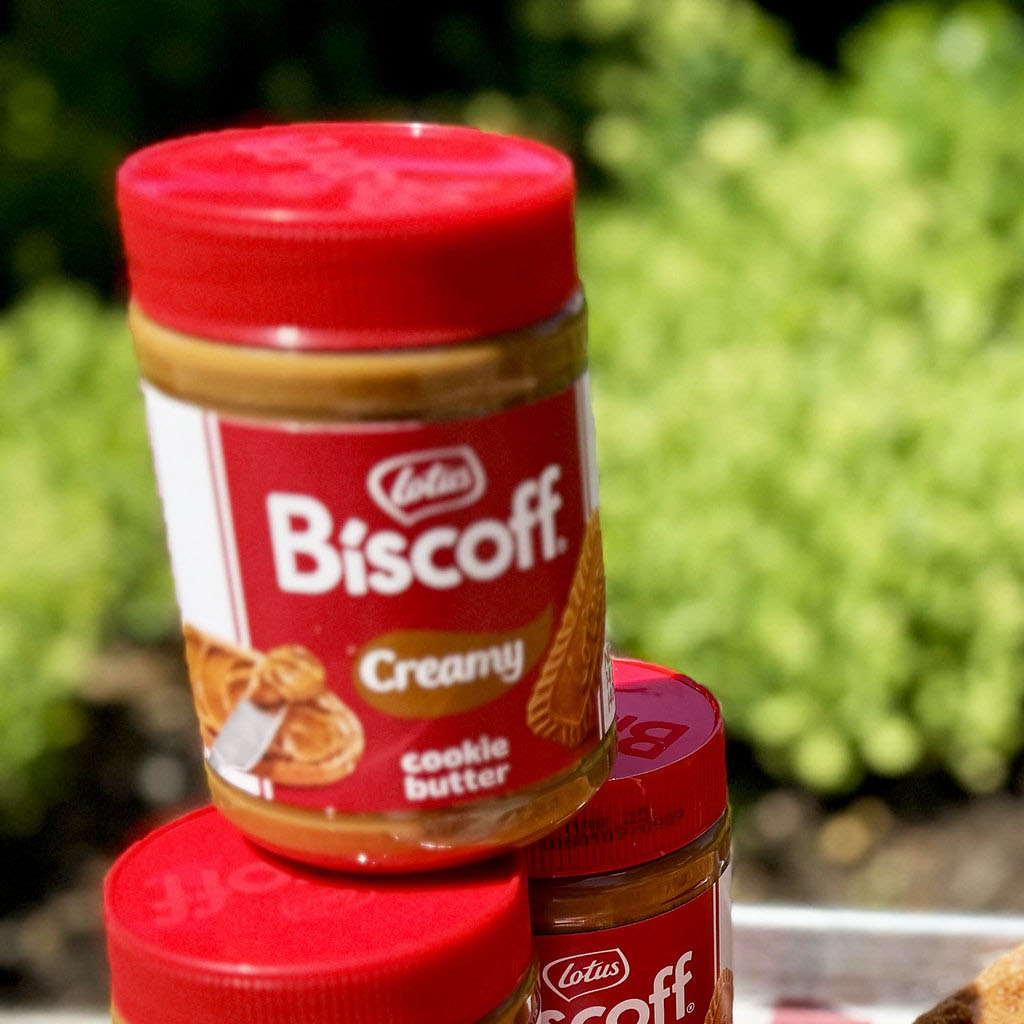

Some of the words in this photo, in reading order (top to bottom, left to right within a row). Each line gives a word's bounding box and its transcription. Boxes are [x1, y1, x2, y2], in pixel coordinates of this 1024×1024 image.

[265, 463, 563, 596] Biscoff
[358, 638, 524, 692] Creamy
[400, 734, 510, 774] cookie
[404, 762, 511, 801] butter
[558, 959, 621, 989] Lotus
